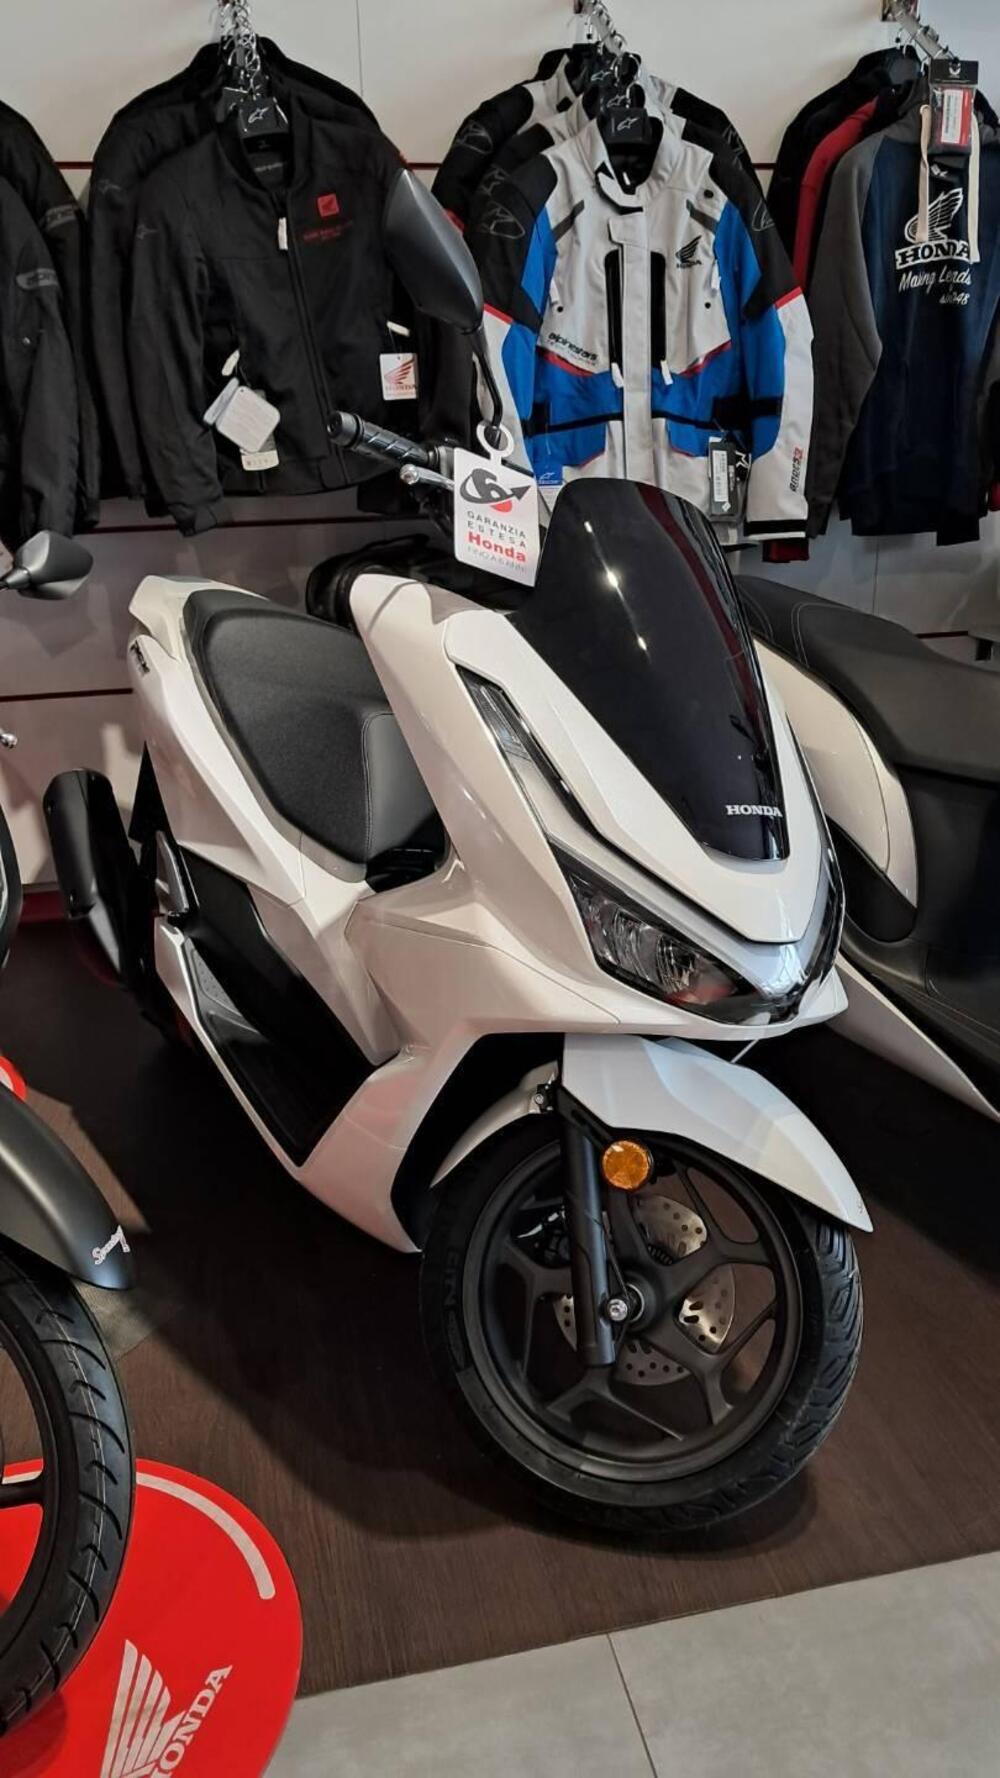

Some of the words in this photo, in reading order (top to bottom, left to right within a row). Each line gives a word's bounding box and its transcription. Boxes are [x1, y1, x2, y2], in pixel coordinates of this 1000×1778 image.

[467, 510, 527, 539] GARANZIA
[467, 520, 527, 548] ESTESA
[468, 531, 527, 562] Honda
[725, 804, 784, 818] HONDA
